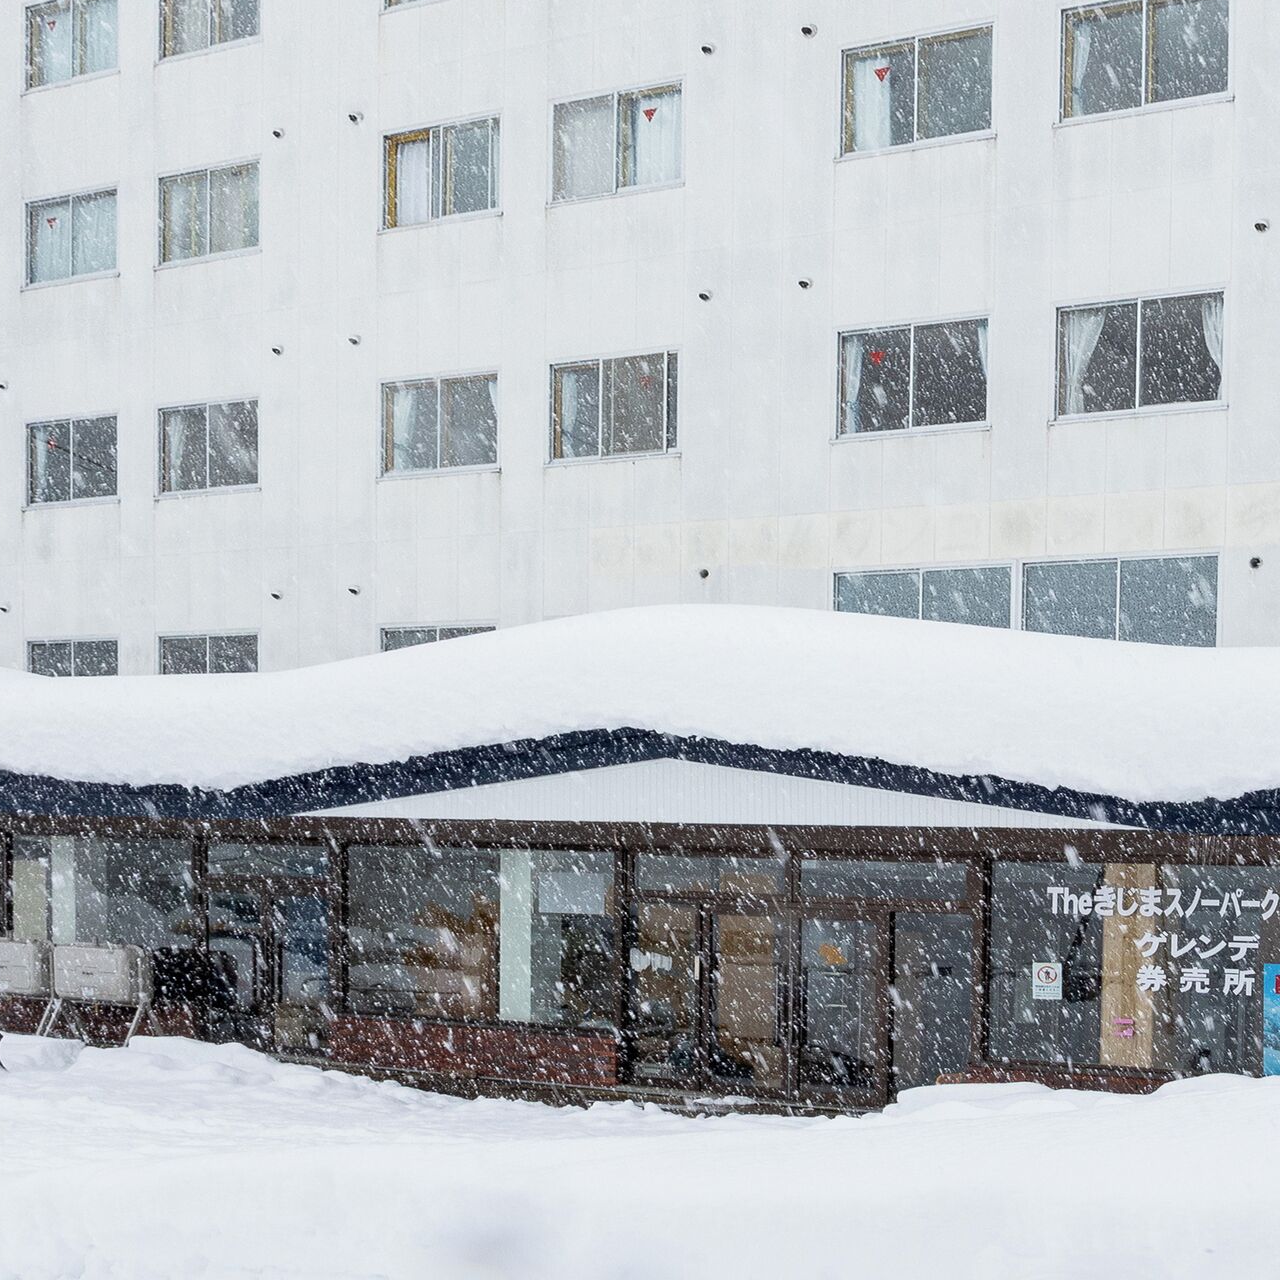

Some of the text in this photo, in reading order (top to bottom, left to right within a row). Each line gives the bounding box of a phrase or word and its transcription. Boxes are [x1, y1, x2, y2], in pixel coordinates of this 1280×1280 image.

[1047, 886, 1279, 920] Theきじまスノーパーク
[1135, 932, 1260, 961] ゲレンデ
[1136, 965, 1255, 996] 券売所
